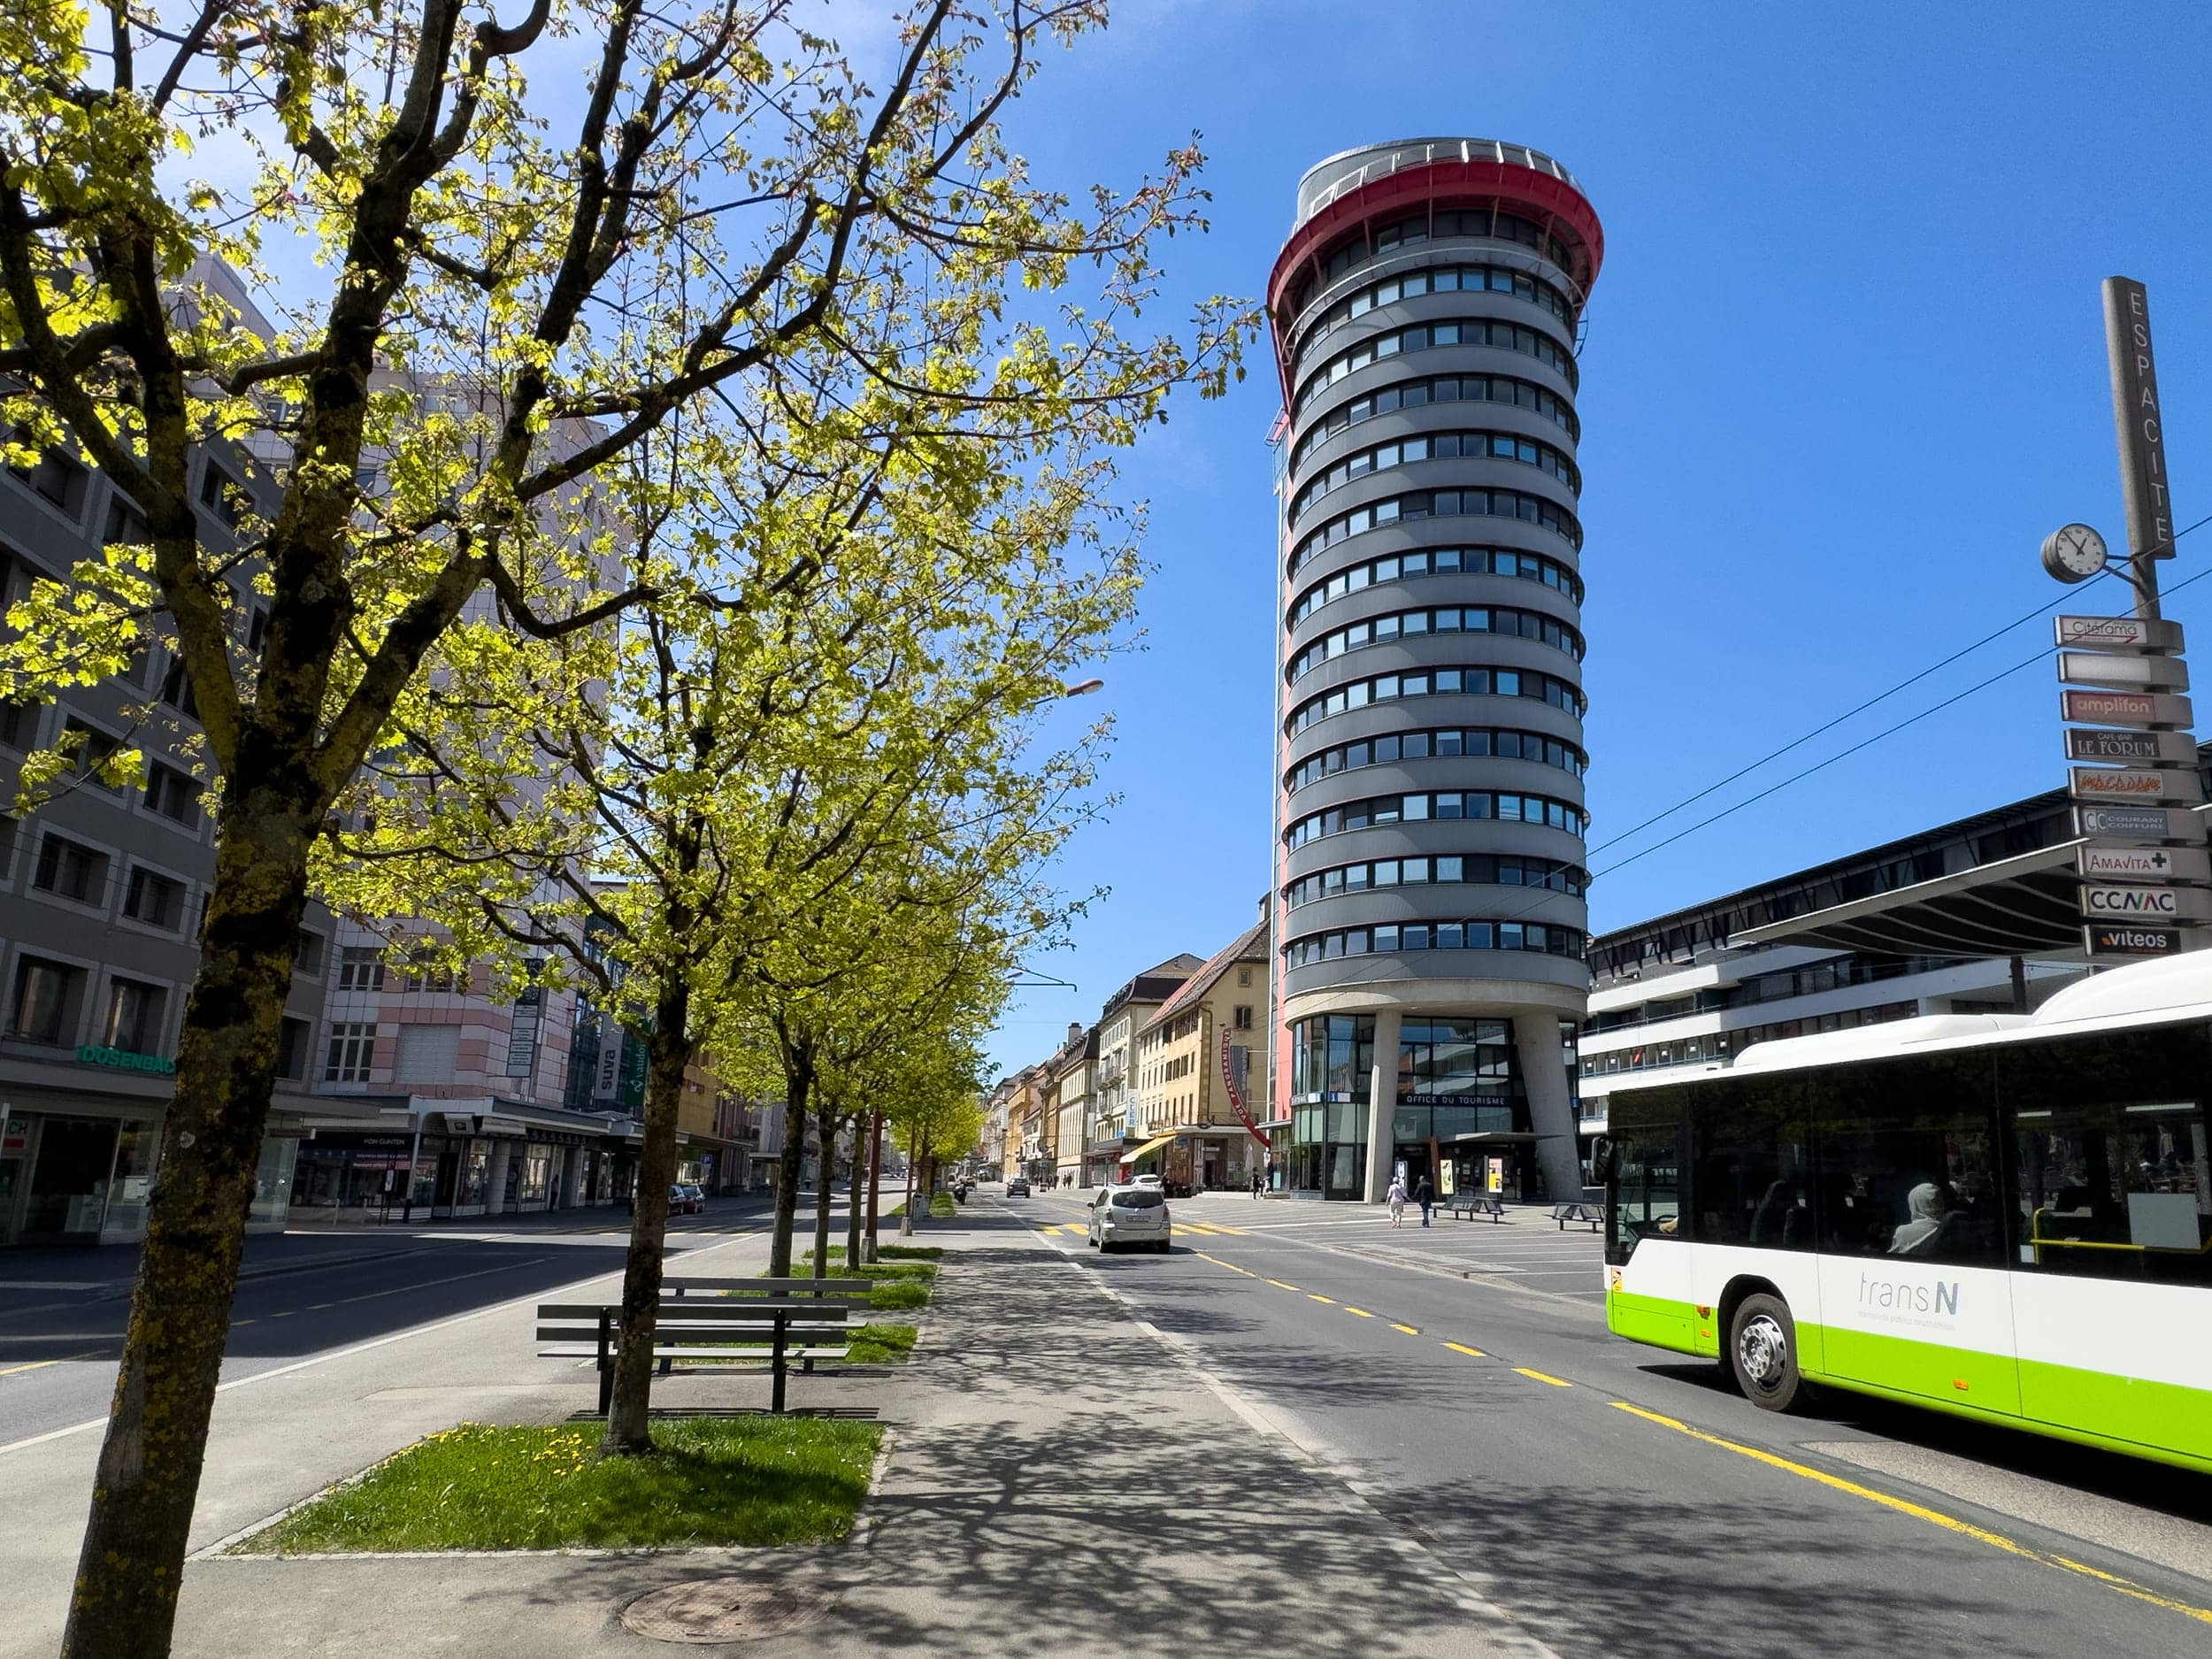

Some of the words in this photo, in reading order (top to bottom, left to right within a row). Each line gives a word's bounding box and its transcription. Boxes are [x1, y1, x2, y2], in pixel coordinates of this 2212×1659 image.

[2077, 697, 2150, 715] amplifon
[2077, 740, 2095, 754] LE
[2100, 741, 2155, 757] FORUM
[2090, 890, 2175, 912] CCNAC
[2108, 930, 2167, 948] viteos
[80, 1046, 175, 1074] DOSENBAC
[601, 1048, 617, 1091] suva
[1459, 1096, 1506, 1105] TOURISME
[1859, 1271, 1960, 1316] transN
